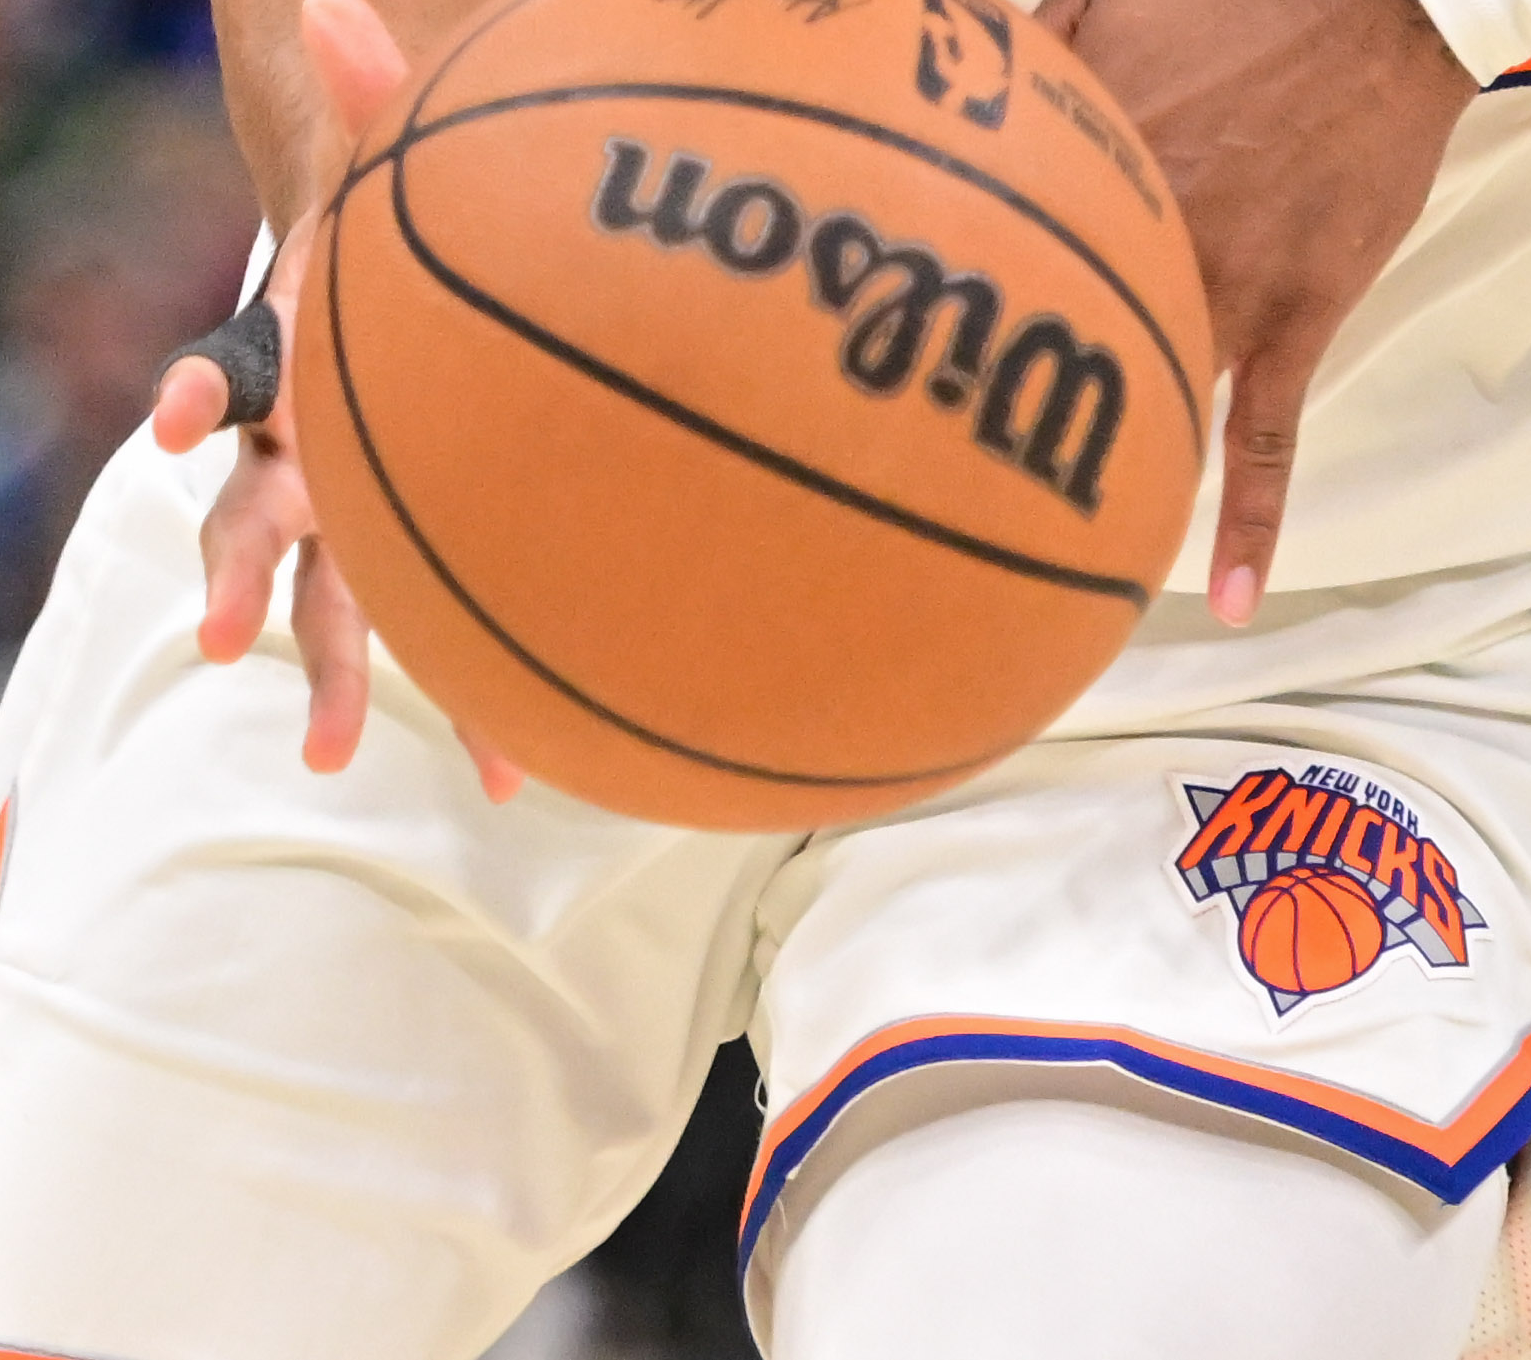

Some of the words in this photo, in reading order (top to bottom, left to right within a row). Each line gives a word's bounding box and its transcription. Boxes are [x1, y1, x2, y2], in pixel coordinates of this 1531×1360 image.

[589, 133, 1130, 523] Wilson
[1174, 766, 1470, 967] KNICKS
[1298, 764, 1361, 795] NEW
[1362, 780, 1420, 837] YORK
